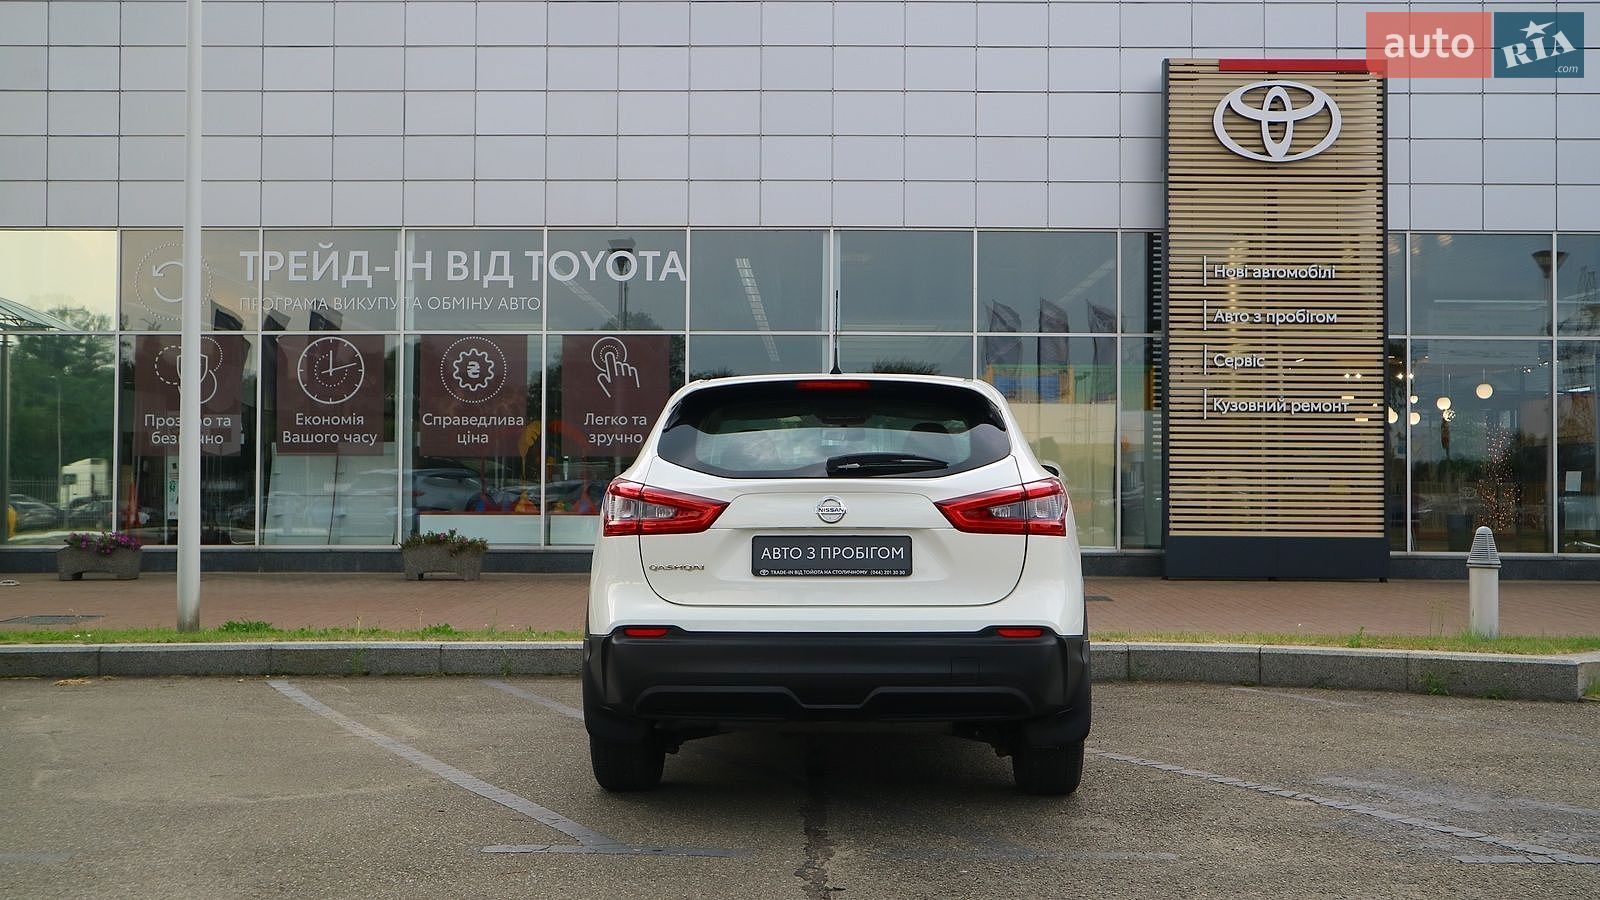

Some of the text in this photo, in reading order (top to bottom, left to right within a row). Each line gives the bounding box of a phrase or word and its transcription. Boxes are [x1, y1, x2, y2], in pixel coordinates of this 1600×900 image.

[239, 242, 687, 289] ТРЕЙД-ІН ВІД TOYOTA
[1213, 264, 1337, 279] Нові автомобілі
[239, 296, 329, 311] ПРОГРАМА
[333, 296, 400, 311] ВИКУПУ
[427, 296, 493, 311] ОБМІНУ
[498, 296, 541, 311] АВТО
[1213, 309, 1338, 326] Авто з пробігом
[1213, 353, 1265, 370] Сервіс
[1213, 397, 1350, 415] Кузовний ремонт
[144, 414, 232, 430] Прозо та
[295, 412, 364, 426] Економія
[422, 412, 524, 429] Справедлива
[583, 412, 648, 426] Легко та
[282, 430, 378, 446] Вашого часу
[457, 430, 489, 446] ціна
[588, 432, 644, 447] зручно
[760, 546, 803, 560] АВТО
[820, 546, 905, 560] ПРОБІГОМ
[649, 564, 705, 572] QASHQAI
